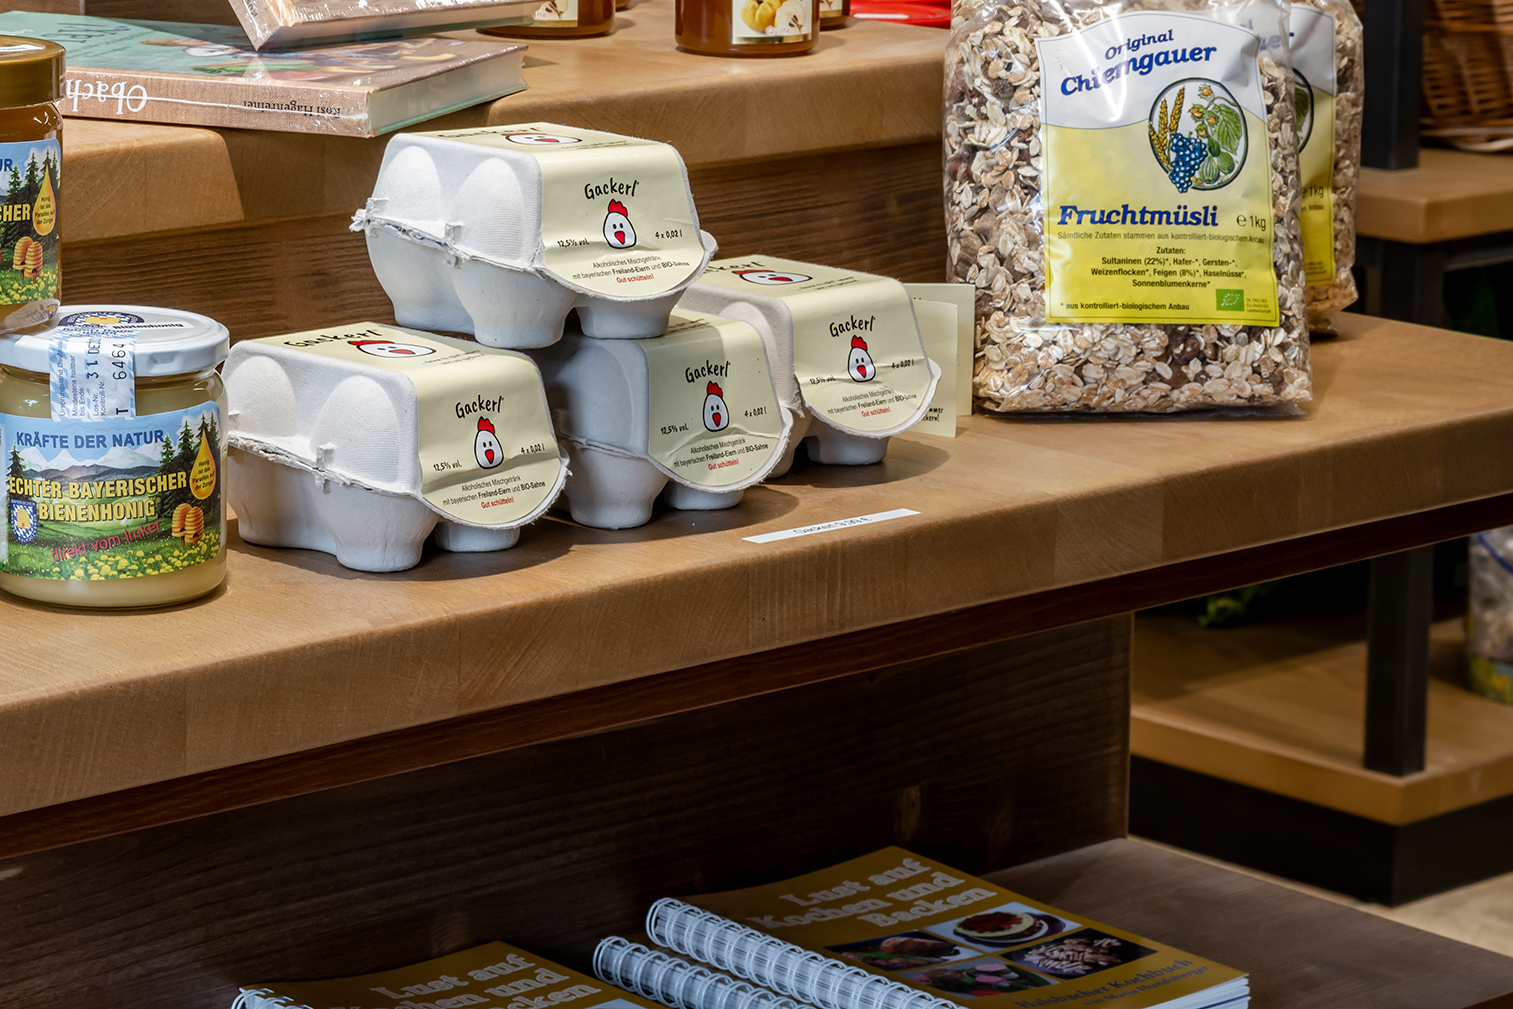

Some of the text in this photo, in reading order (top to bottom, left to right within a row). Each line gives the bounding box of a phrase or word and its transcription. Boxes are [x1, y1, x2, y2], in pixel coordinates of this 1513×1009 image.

[1104, 28, 1174, 61] Original
[1060, 45, 1217, 96] Chiemgauer
[584, 177, 638, 200] Gackerl
[1057, 203, 1267, 232] Fruchtmüsli 1kg
[1057, 231, 1093, 240] Sämtliche
[1094, 232, 1122, 240] Zutaten
[1123, 232, 1155, 240] stammen
[1171, 232, 1248, 243] kontrolliert-biologischem
[1101, 257, 1142, 265] Sultaninen
[1156, 246, 1186, 255] Zutaten:
[593, 258, 627, 269] Alkoholisches
[612, 265, 651, 275] Freiland-Eiern
[1153, 268, 1178, 278] Feigen
[1065, 301, 1190, 311] aus kontrolliert-biologischem Anbau
[829, 314, 874, 338] Gackerl
[111, 343, 127, 380] 6464
[685, 359, 729, 383] Gackerl
[116, 407, 129, 415] T
[455, 394, 503, 419] Gackerl
[16, 429, 164, 448] KRÄFTE DER NATUR
[660, 425, 678, 435] 12,5%
[530, 444, 542, 454] 0,02
[690, 444, 719, 454] Alkoholisches
[706, 449, 737, 460] Freiland-Eiern
[745, 443, 769, 453] BIO-Sahne
[433, 461, 452, 472] 12,5%
[9, 471, 187, 499] ECHTER BAYERISCHER
[451, 481, 546, 505] bayerischen Freiland-Eiern BIO-Sahne
[461, 474, 522, 492] Alkoholisches Mischgetränk
[481, 497, 515, 509] Gut schütteln!
[51, 518, 161, 562] direkt vom Imker
[778, 857, 933, 910] Lust auf
[746, 871, 966, 929] Kochen und
[856, 886, 998, 928] Backen
[369, 952, 536, 1000] Lust auf
[483, 966, 571, 998] und
[1111, 955, 1195, 990] Kochbuch
